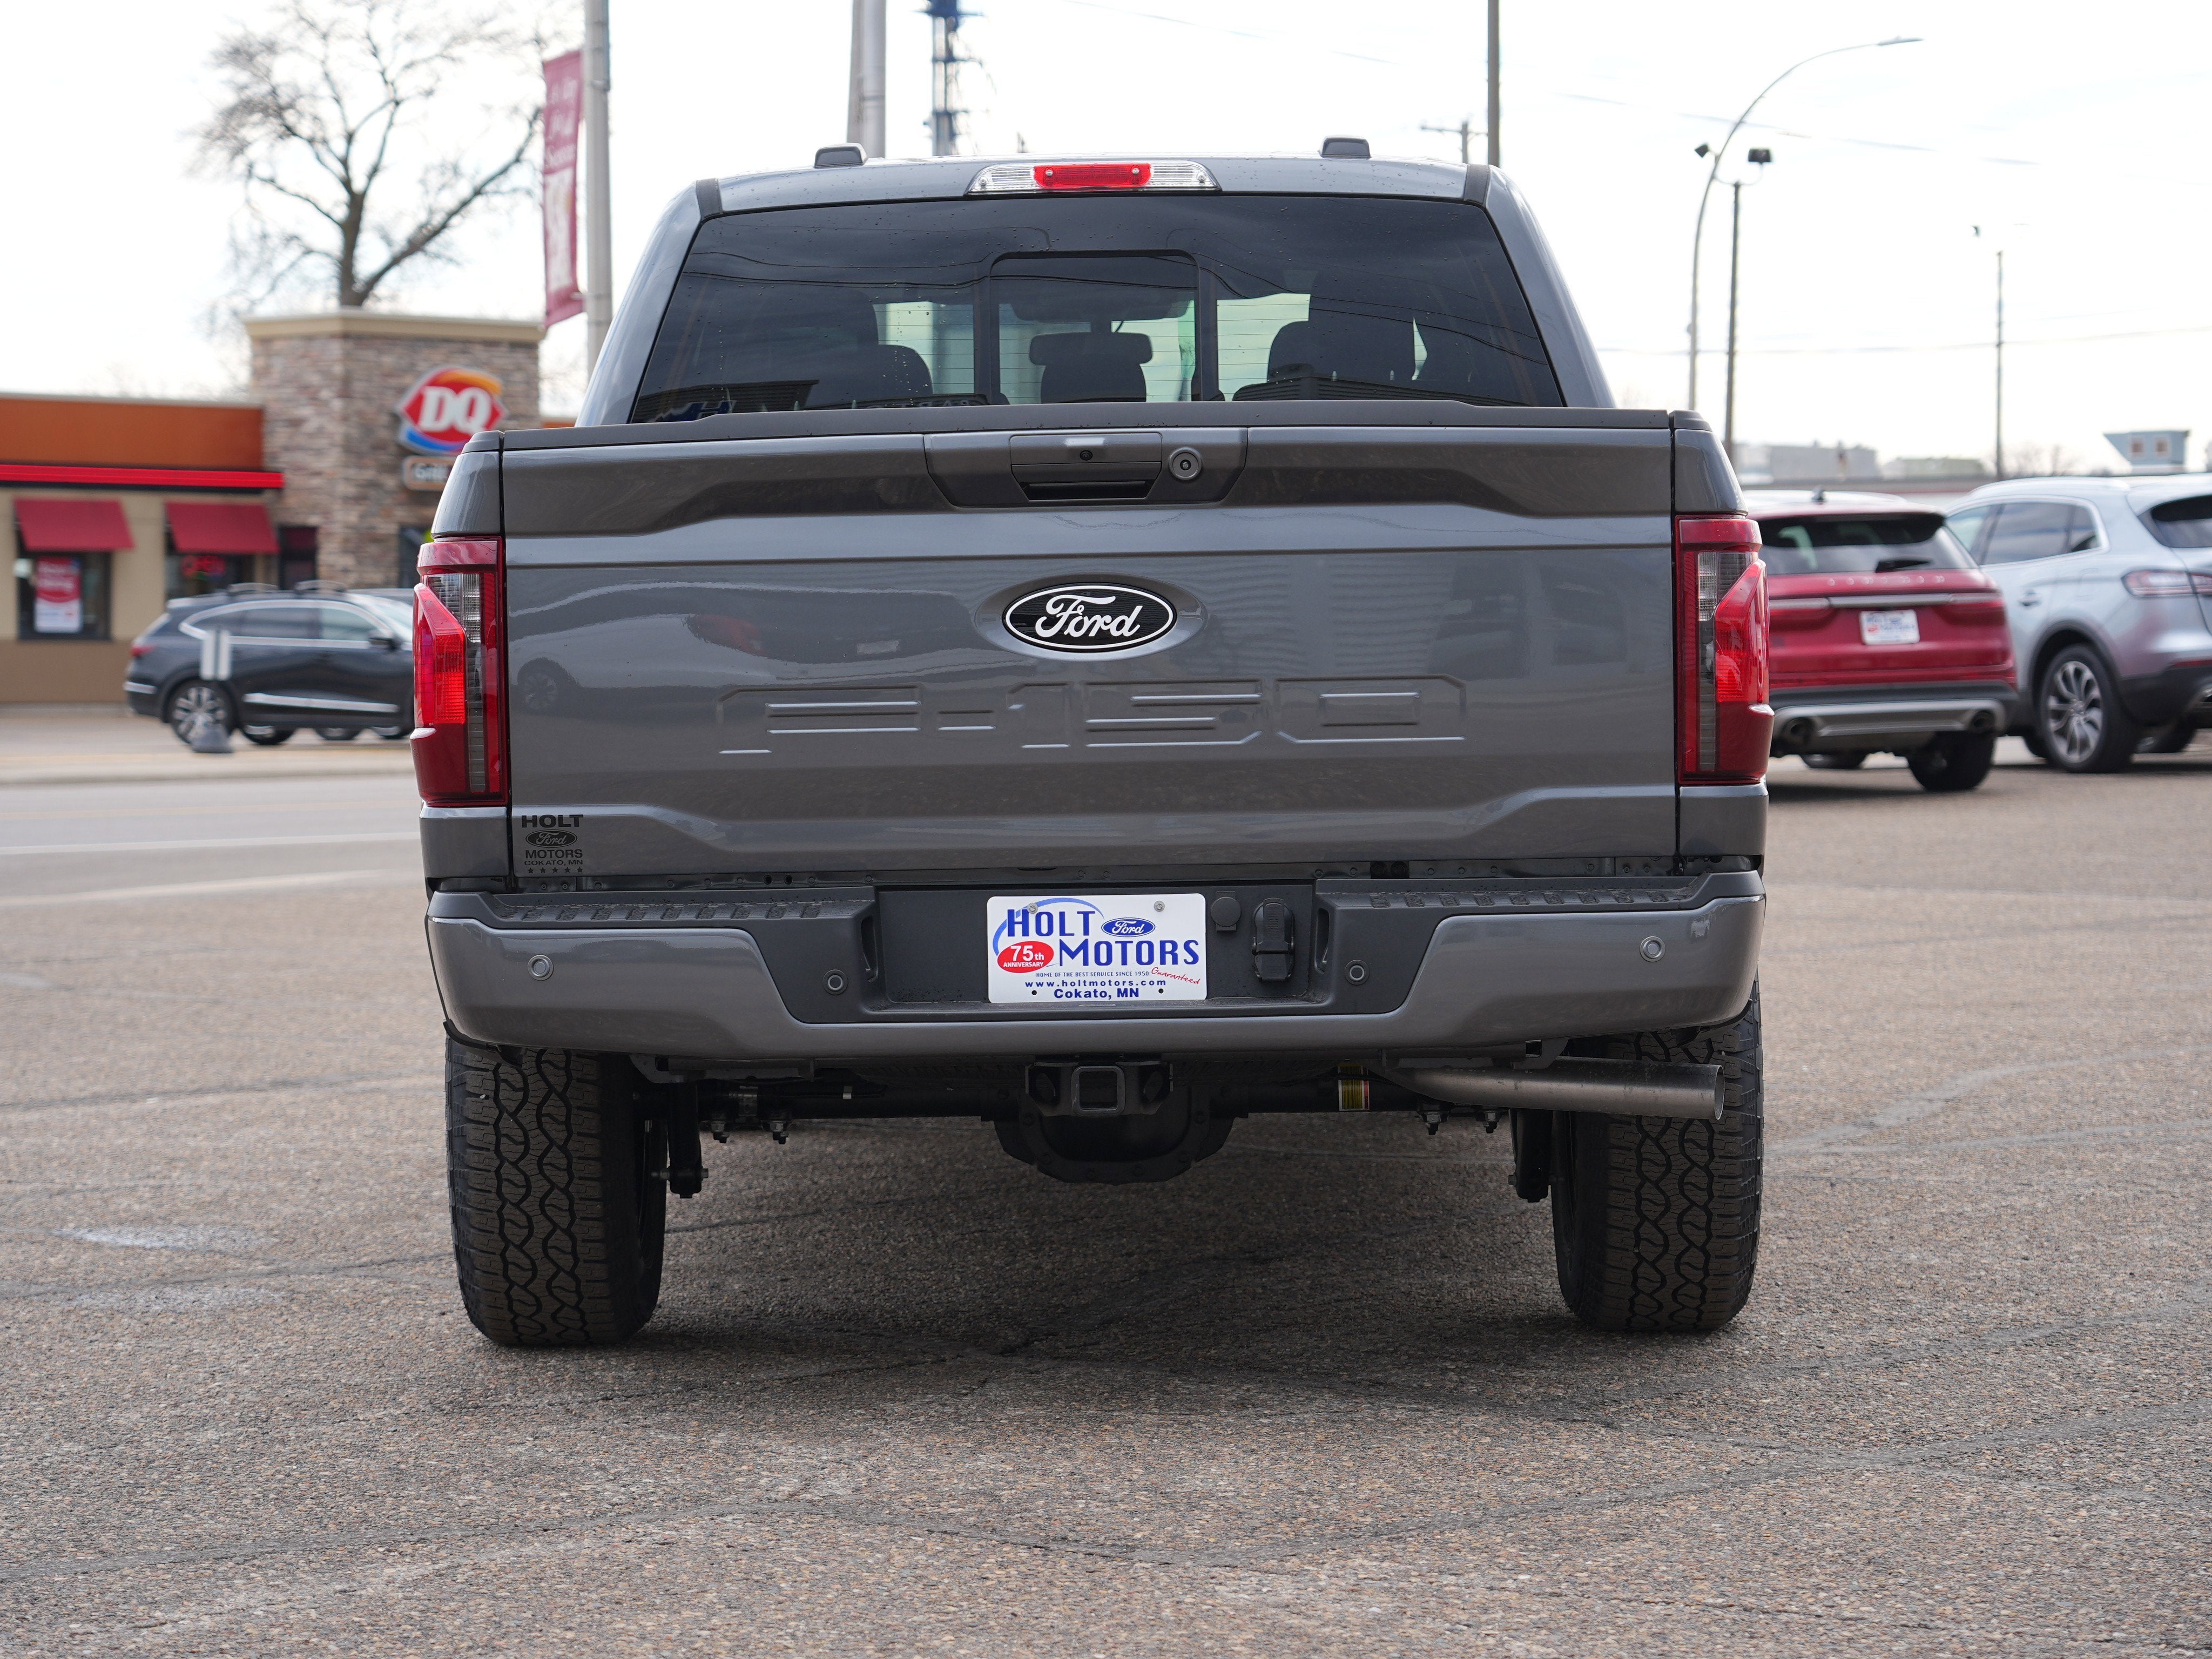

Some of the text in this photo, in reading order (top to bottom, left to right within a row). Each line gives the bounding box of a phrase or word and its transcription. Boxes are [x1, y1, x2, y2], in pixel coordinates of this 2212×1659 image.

[419, 386, 491, 434] DQ
[1035, 595, 1143, 638] Ford
[716, 674, 1467, 754] F-150
[521, 814, 584, 828] HOLT
[536, 832, 567, 845] Ford
[525, 849, 583, 859] MOTORS
[1007, 909, 1095, 936] HOLT
[1112, 920, 1145, 934] Ford
[1010, 945, 1044, 961] 75th
[1059, 938, 1199, 967] MOTORS
[1151, 967, 1201, 984] Guaranteed
[1054, 988, 1139, 1000] Cokato, MN
